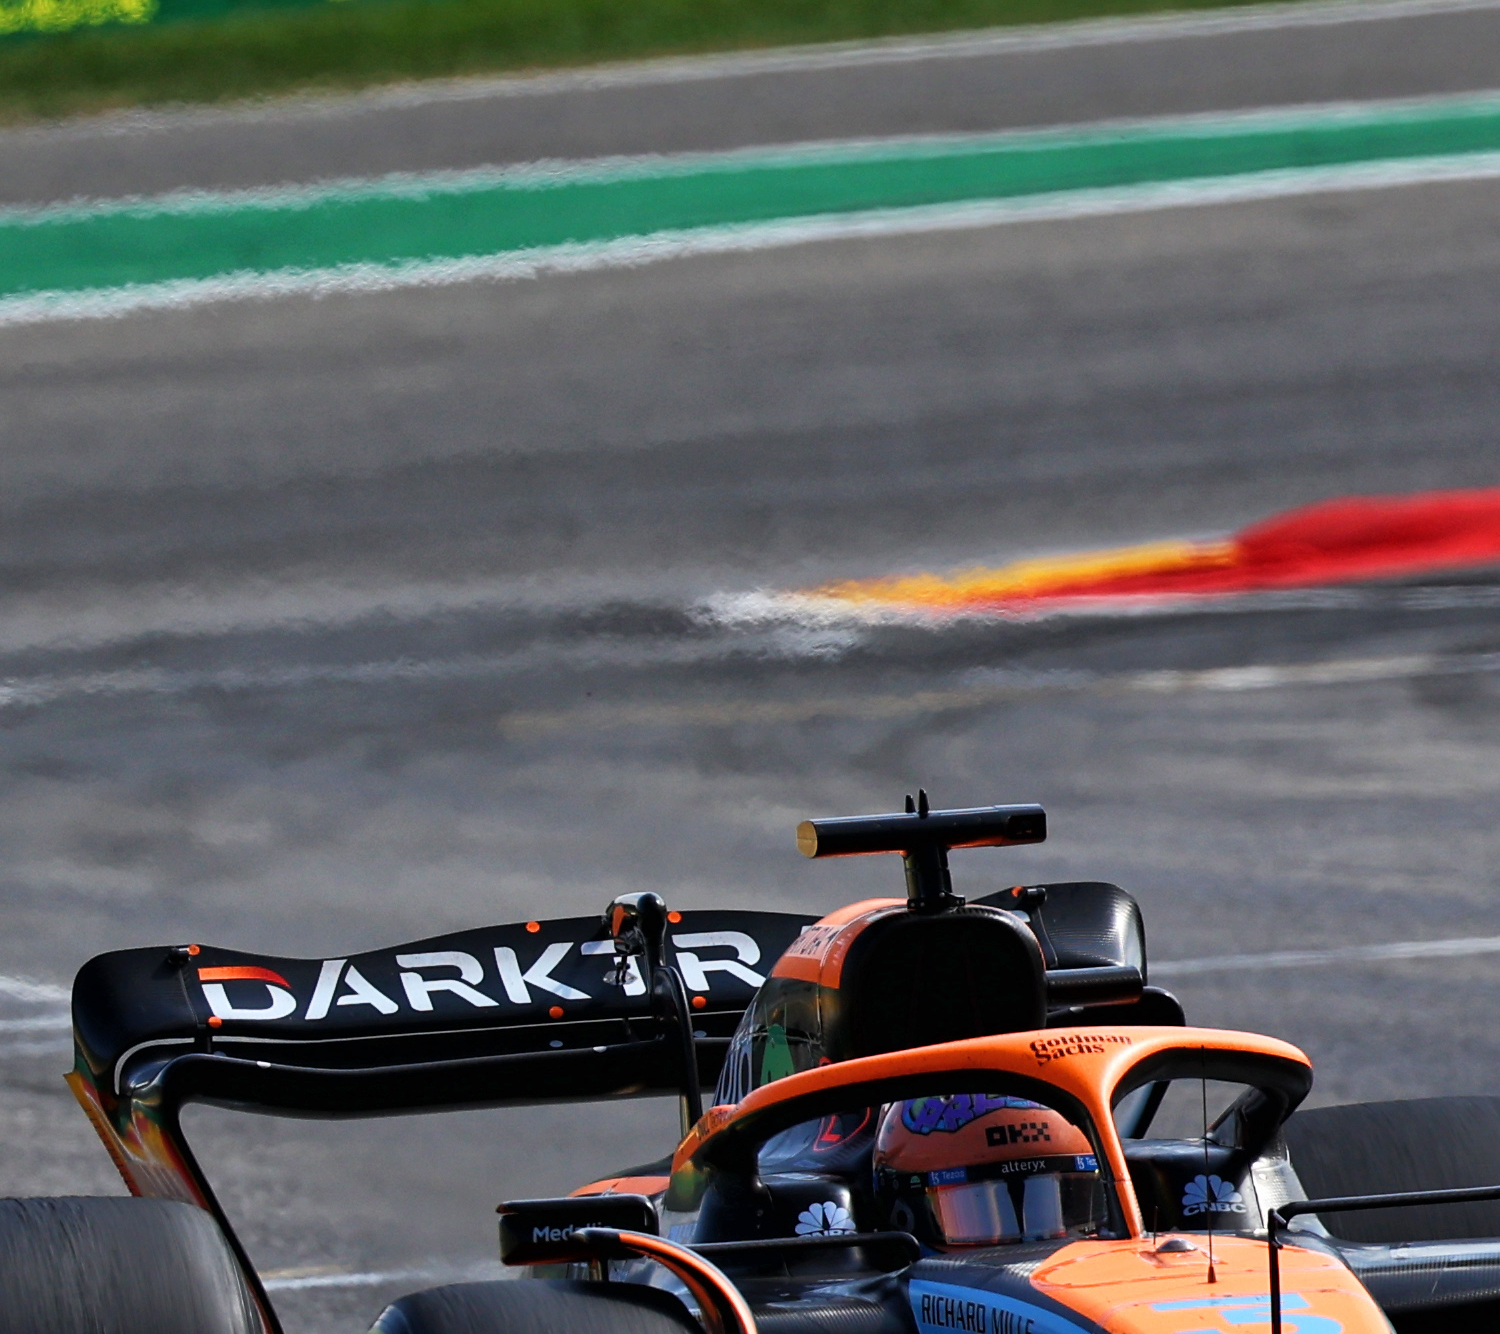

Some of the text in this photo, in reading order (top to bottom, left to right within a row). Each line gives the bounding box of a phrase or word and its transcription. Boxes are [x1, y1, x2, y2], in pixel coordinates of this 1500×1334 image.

[1030, 1033, 1132, 1053] Goldman
[1034, 1042, 1105, 1066] Sachs
[985, 1122, 1051, 1147] OKX
[942, 1169, 965, 1180] Tezos
[1001, 1159, 1047, 1174] alteryx
[1182, 1202, 1247, 1216] CNBC
[920, 1293, 986, 1334] RICHARD
